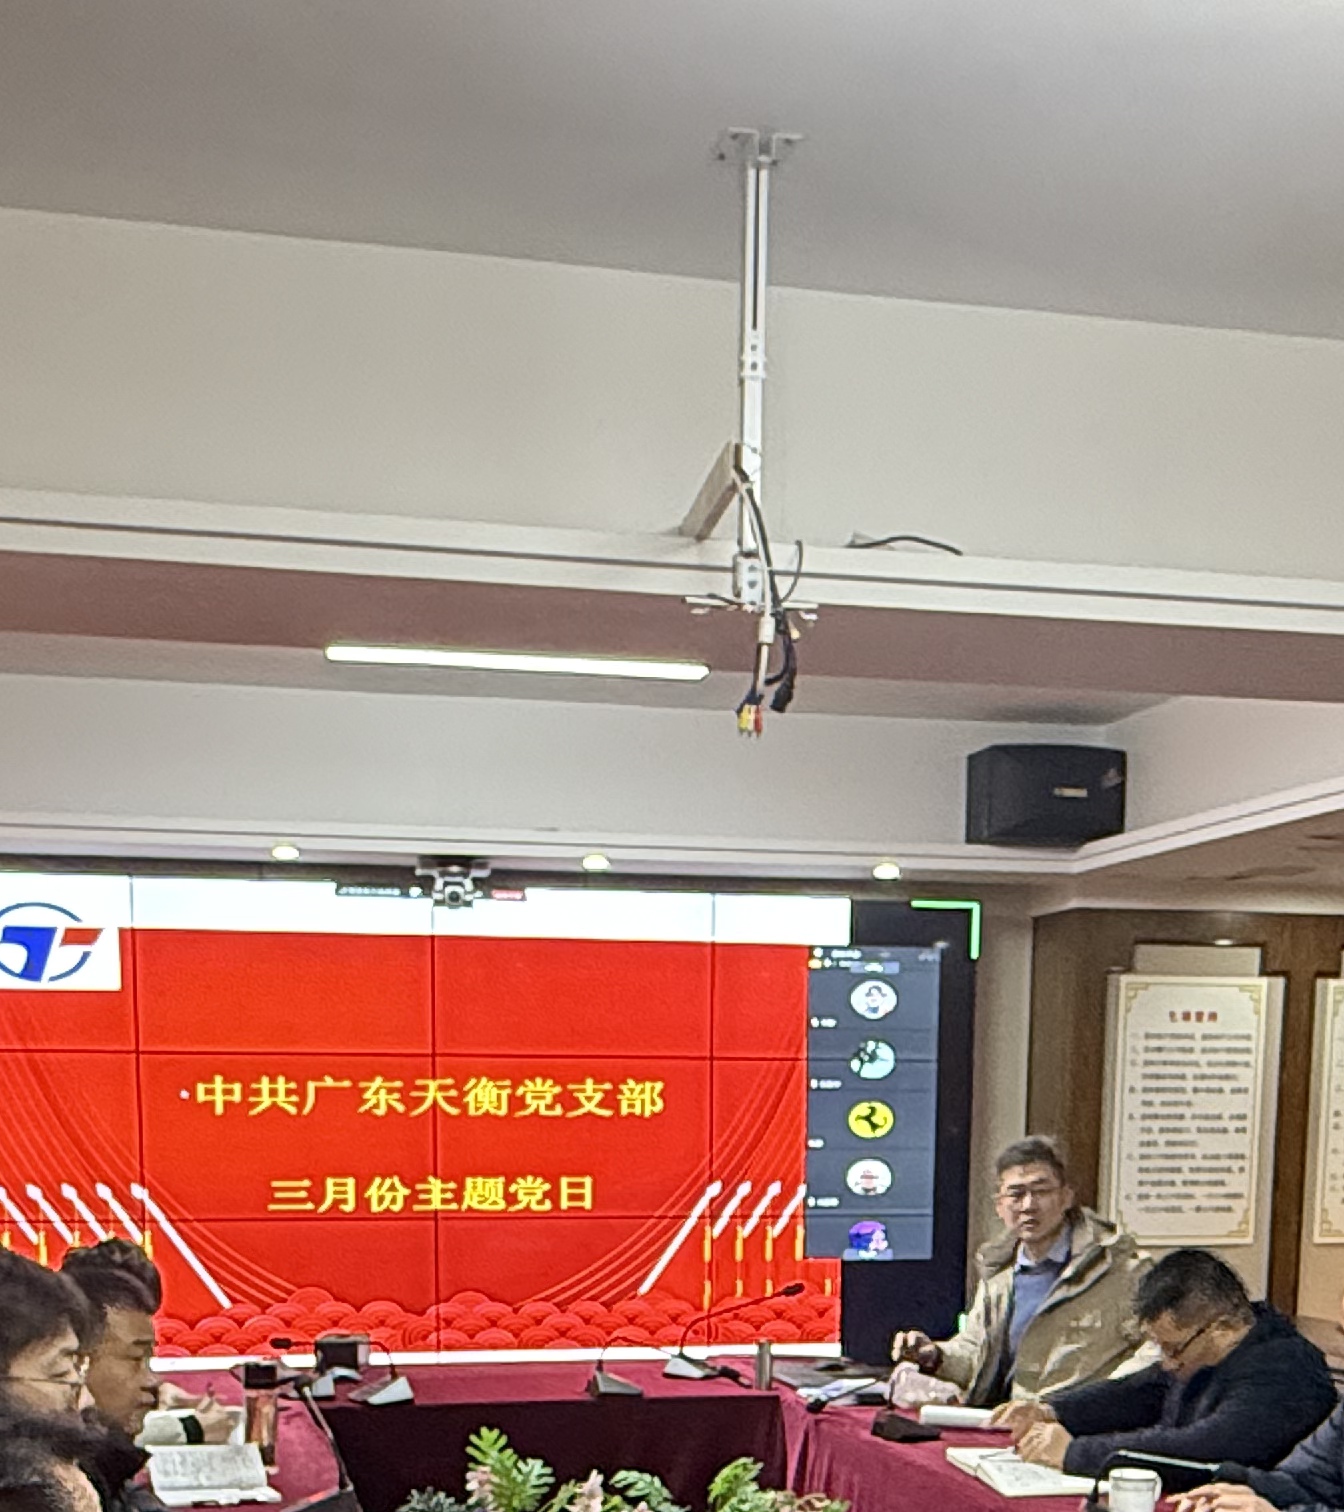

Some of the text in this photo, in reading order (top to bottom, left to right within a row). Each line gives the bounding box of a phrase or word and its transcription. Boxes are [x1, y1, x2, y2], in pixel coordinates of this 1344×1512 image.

[196, 1075, 666, 1118] 中共广东天衡党支部
[267, 1175, 595, 1213] 三月份主题党日
